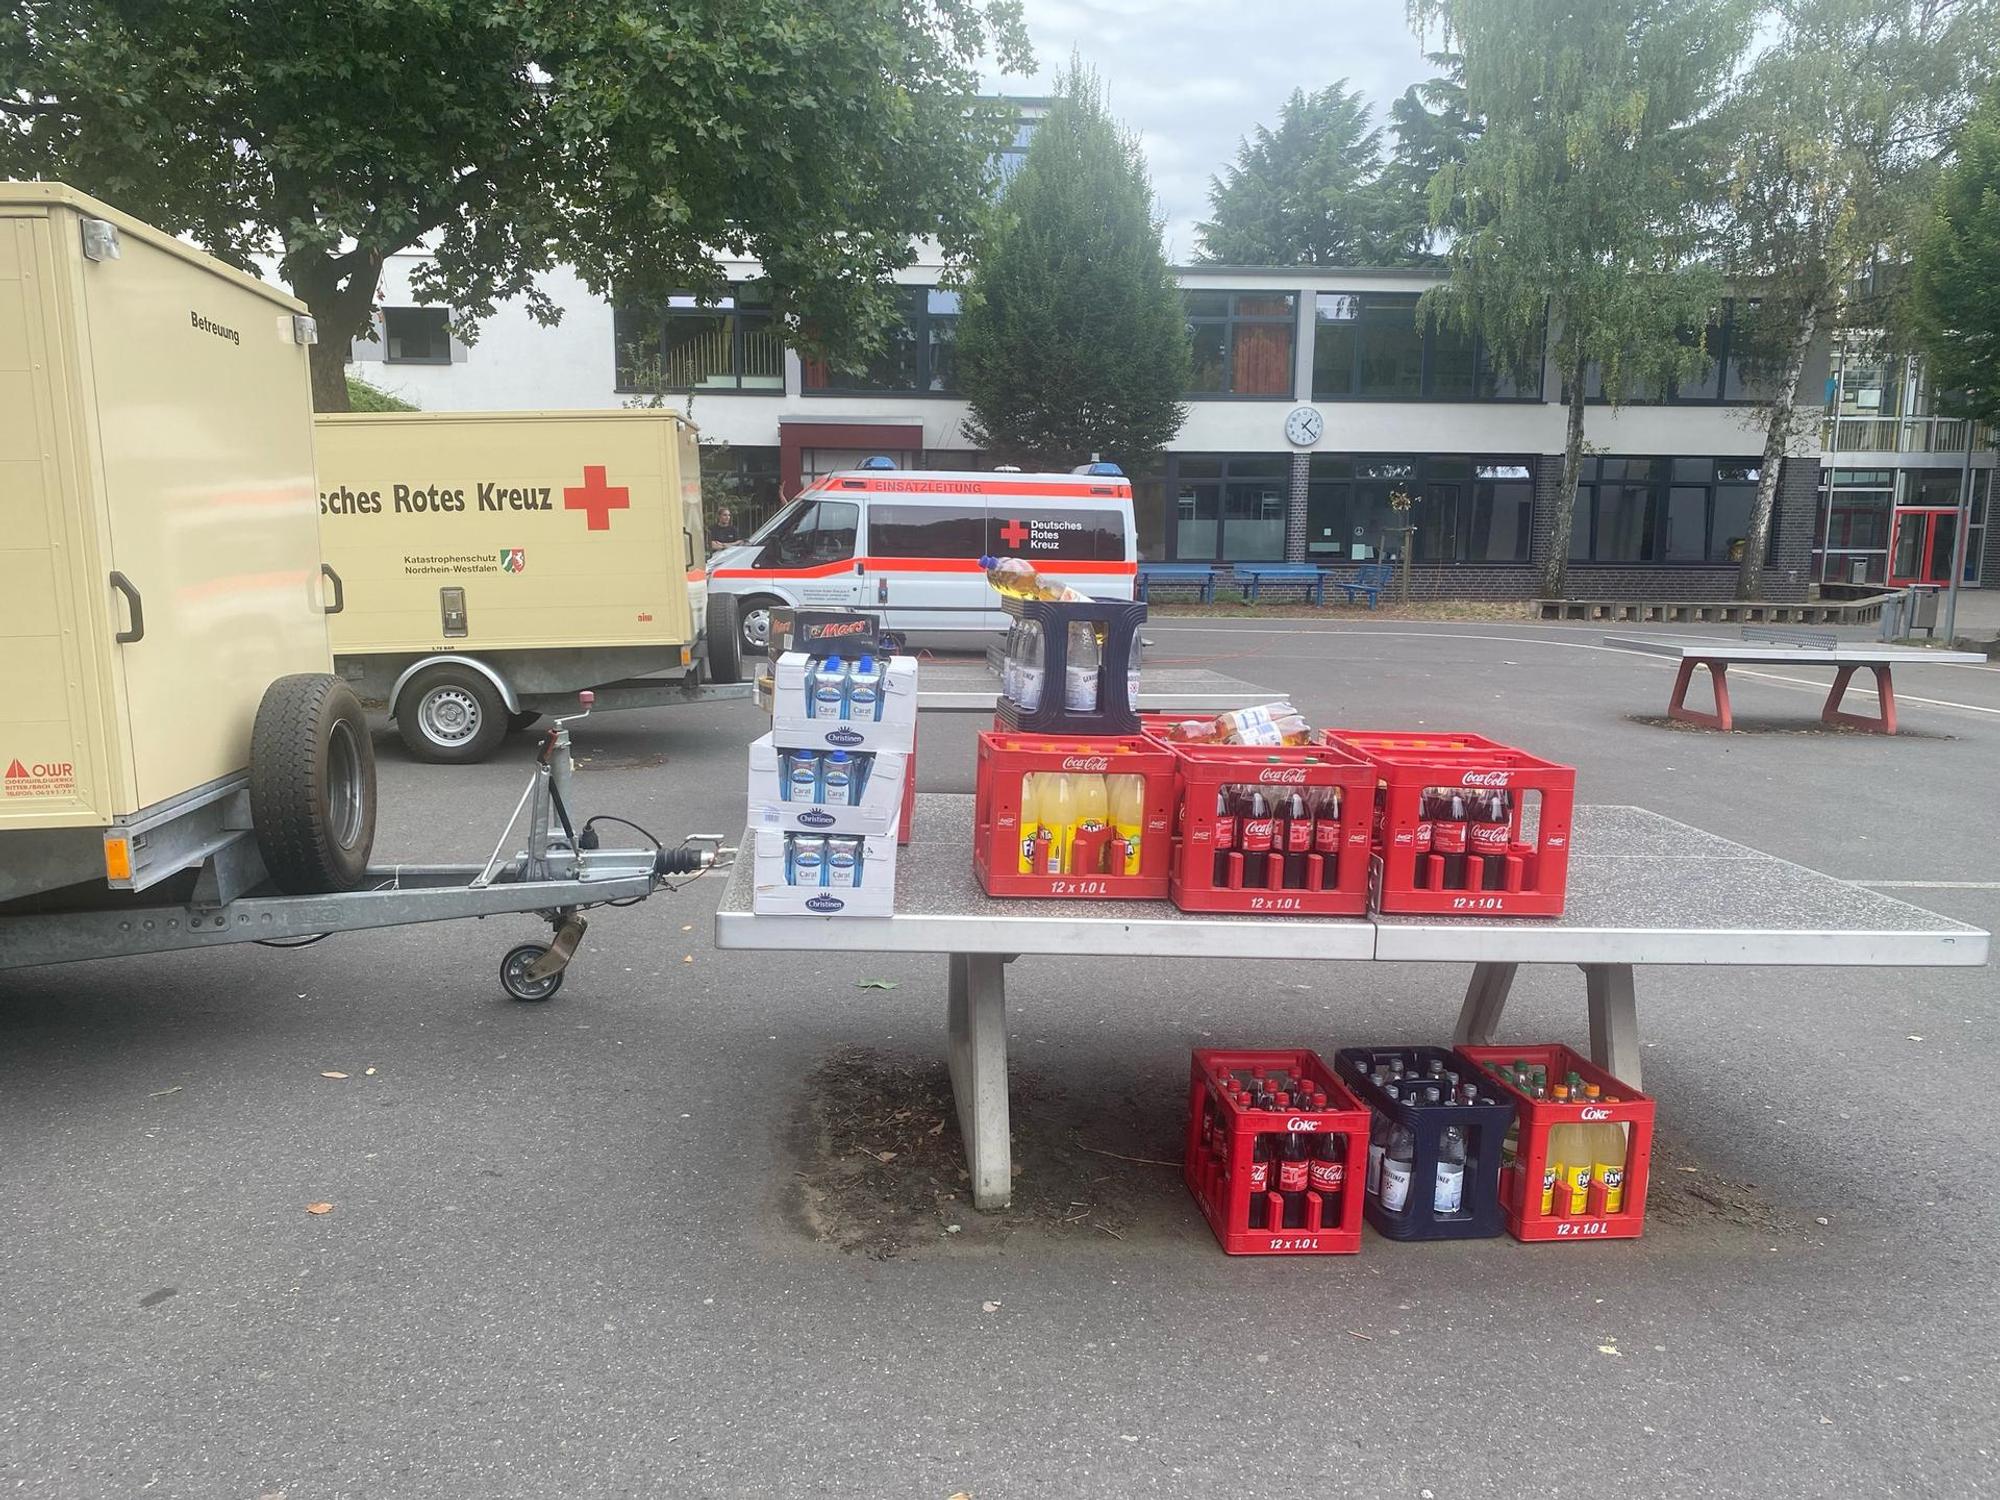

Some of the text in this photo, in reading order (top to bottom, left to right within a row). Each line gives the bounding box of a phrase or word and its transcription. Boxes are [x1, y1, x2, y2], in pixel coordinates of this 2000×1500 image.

[190, 310, 240, 346] Betreuung
[875, 481, 982, 493] EINSATZLEITUNG
[393, 483, 465, 513] Rotes
[477, 482, 553, 512] Kreuz
[1031, 519, 1082, 531] Deutsches
[1031, 530, 1059, 540] Rotes
[1031, 540, 1060, 549] Kreuz
[403, 555, 497, 564] Katastrophenschutz
[405, 565, 498, 574] Nordrhein-Westfalen
[32, 763, 73, 776] OWR
[1062, 756, 1109, 771] Coca-Cola
[1259, 768, 1307, 783] Coca-Cola
[1462, 771, 1511, 786] Coca-Cola
[1050, 882, 1066, 893] 12
[1080, 882, 1097, 893] 1.0
[1099, 882, 1107, 893] L
[807, 899, 843, 909] Christinen
[1250, 897, 1264, 909] 12
[1277, 897, 1293, 909] 1.0
[1294, 897, 1302, 909] L
[1453, 898, 1465, 909] 12
[1479, 898, 1495, 909] 1.0
[1496, 898, 1503, 909] L
[1581, 1107, 1610, 1120] Coke
[1287, 1117, 1319, 1131] Coke
[1556, 1223, 1570, 1235] 12
[1583, 1223, 1599, 1235] 1.0
[1600, 1223, 1608, 1235] L
[1270, 1239, 1282, 1249] 12
[1294, 1239, 1310, 1249] 1.0
[1312, 1239, 1318, 1249] L
